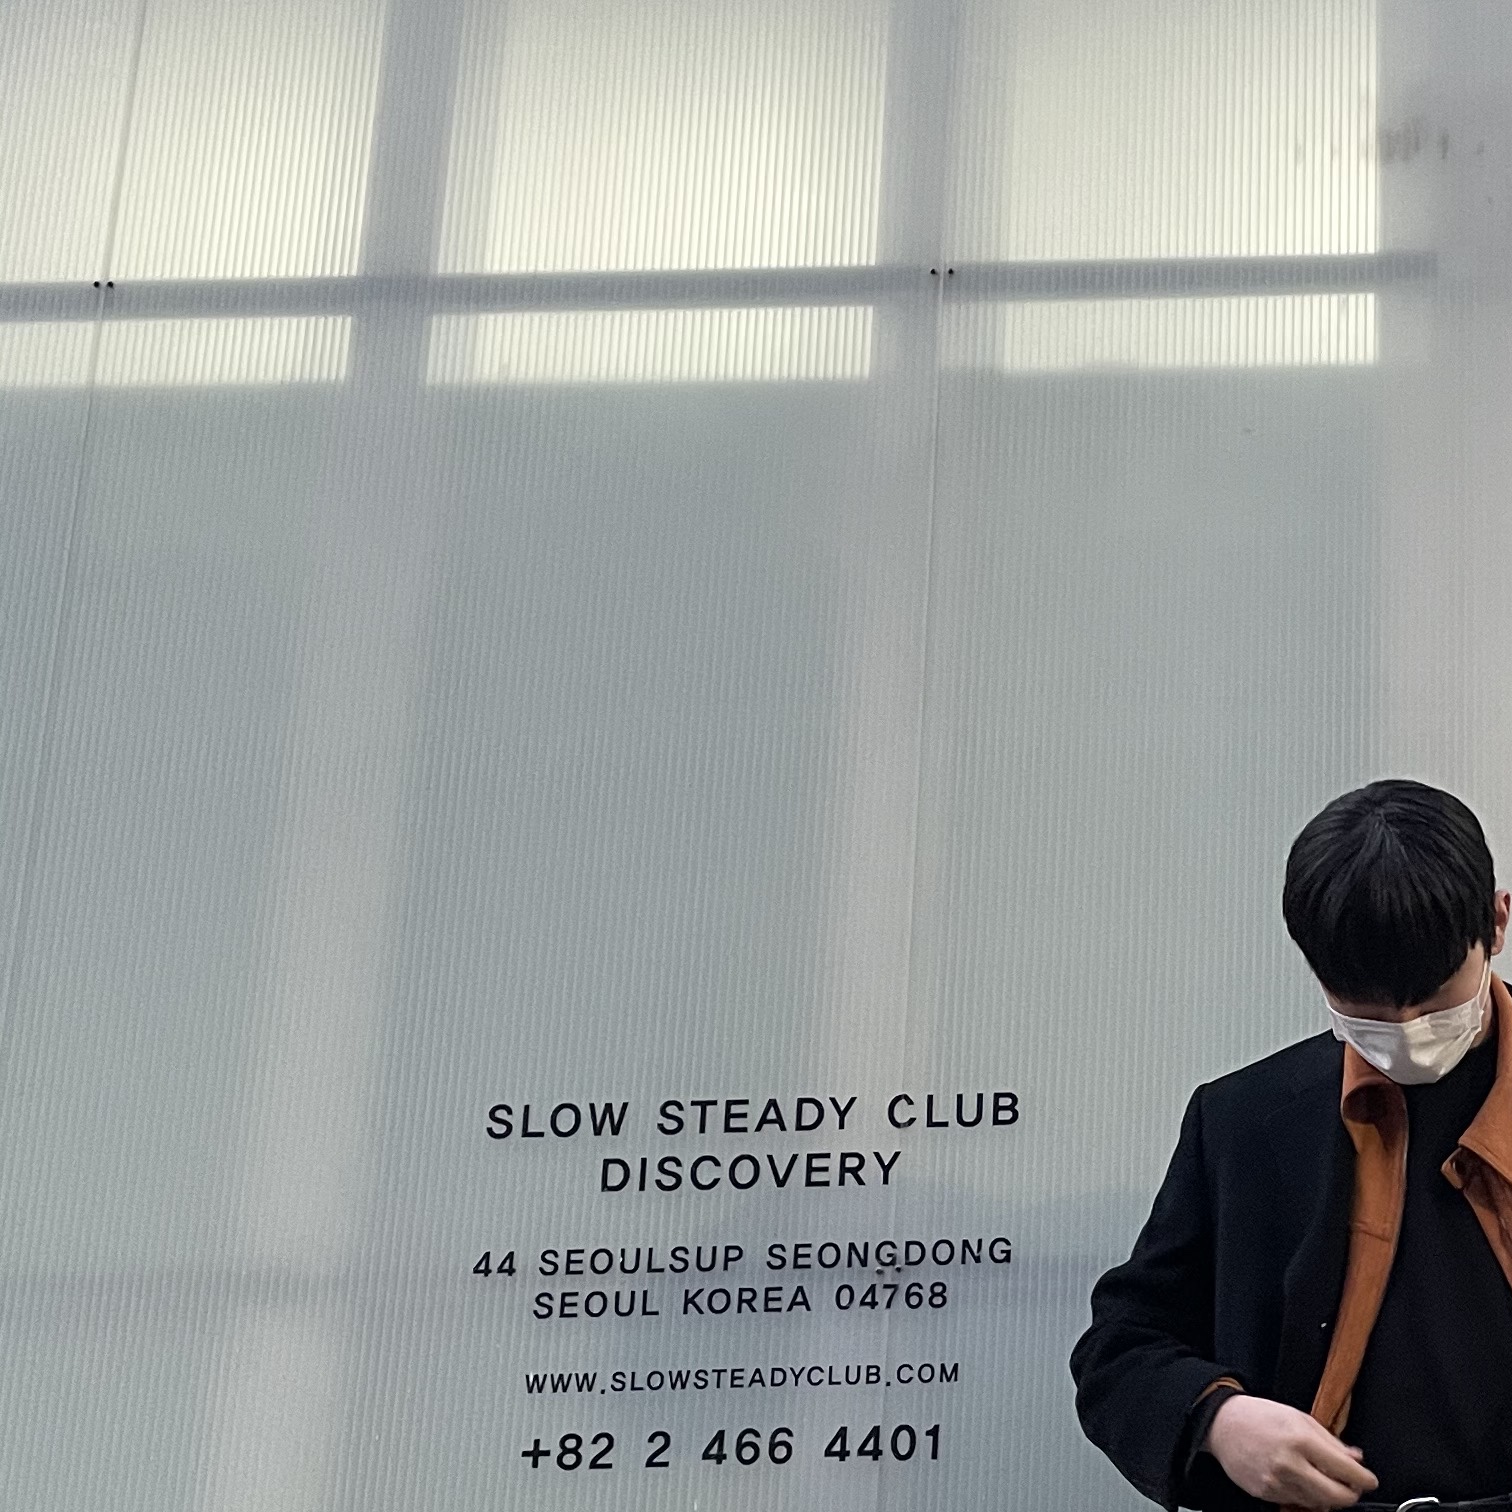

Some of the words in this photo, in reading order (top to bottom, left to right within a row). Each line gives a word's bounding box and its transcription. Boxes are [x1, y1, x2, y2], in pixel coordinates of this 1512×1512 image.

[486, 1101, 629, 1140] SLOW
[656, 1096, 858, 1136] STEADY
[887, 1092, 1019, 1129] CLUB
[600, 1150, 902, 1193] DISCOVERY
[472, 1250, 517, 1278] 44
[538, 1245, 744, 1277] SEOULSUP
[766, 1237, 1012, 1271] SEONGDONG
[532, 1289, 660, 1320] SEOUL
[682, 1285, 812, 1315] KOREA
[835, 1281, 948, 1311] 04768
[525, 1362, 959, 1395] WWW.SLOWSTEADYCLUB.COM
[521, 1432, 615, 1471] +82
[644, 1430, 671, 1468] 2
[701, 1426, 794, 1466] 466
[823, 1423, 941, 1462] 4401
